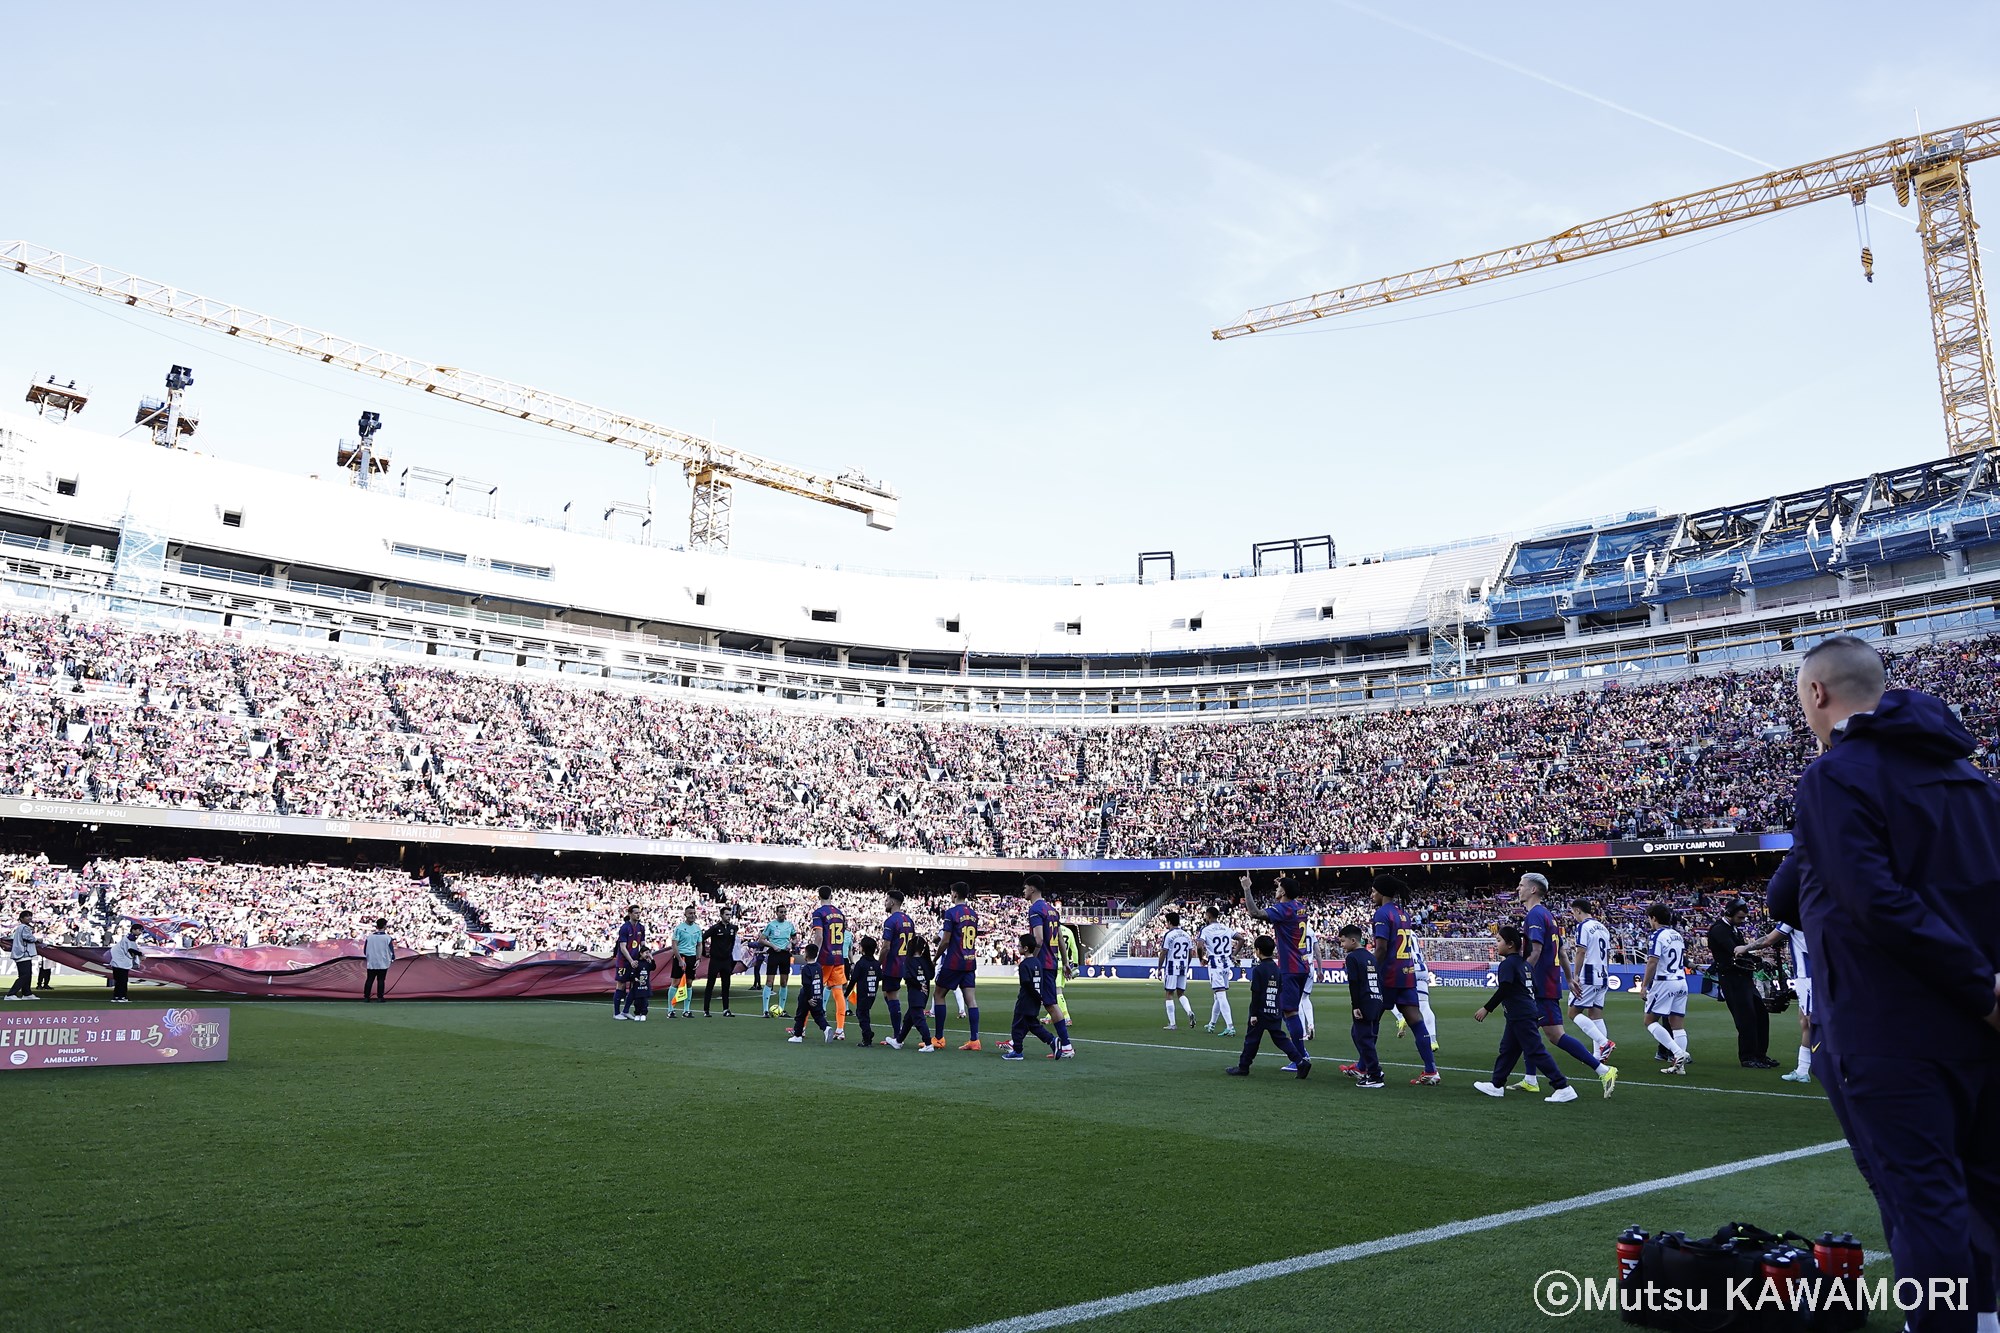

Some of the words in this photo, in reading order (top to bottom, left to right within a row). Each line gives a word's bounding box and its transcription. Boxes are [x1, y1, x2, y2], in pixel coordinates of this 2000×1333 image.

[34, 804, 75, 815] SPOTIFY
[77, 807, 104, 817] CAMP
[106, 809, 126, 818] NOU
[214, 815, 226, 825] FC
[228, 815, 281, 829] BARCELONA
[325, 821, 350, 833] 00:00
[390, 824, 427, 838] LEVANTE
[429, 827, 441, 839] UD
[1654, 842, 1684, 851] SPOTIFY
[1686, 842, 1707, 850] CAMP
[1709, 840, 1725, 848] NOU
[916, 855, 935, 866] DEL
[937, 857, 969, 867] NORD
[1420, 853, 1429, 862] O
[1433, 851, 1456, 861] DEL
[1460, 849, 1497, 860] NORD
[1159, 861, 1170, 870] SI
[1174, 860, 1194, 869] DEL
[1197, 859, 1221, 868] SUD
[1070, 916, 1099, 924] SOSES
[830, 923, 843, 944] 13
[961, 926, 976, 949] 18
[1173, 942, 1188, 959] 23
[1213, 936, 1229, 954] 22
[7, 1017, 36, 1025] NEW
[38, 1016, 67, 1024] YEAR
[72, 1016, 100, 1024] 2026
[14, 1028, 79, 1047] FUTURE
[43, 1056, 88, 1064] AMBILIGHT
